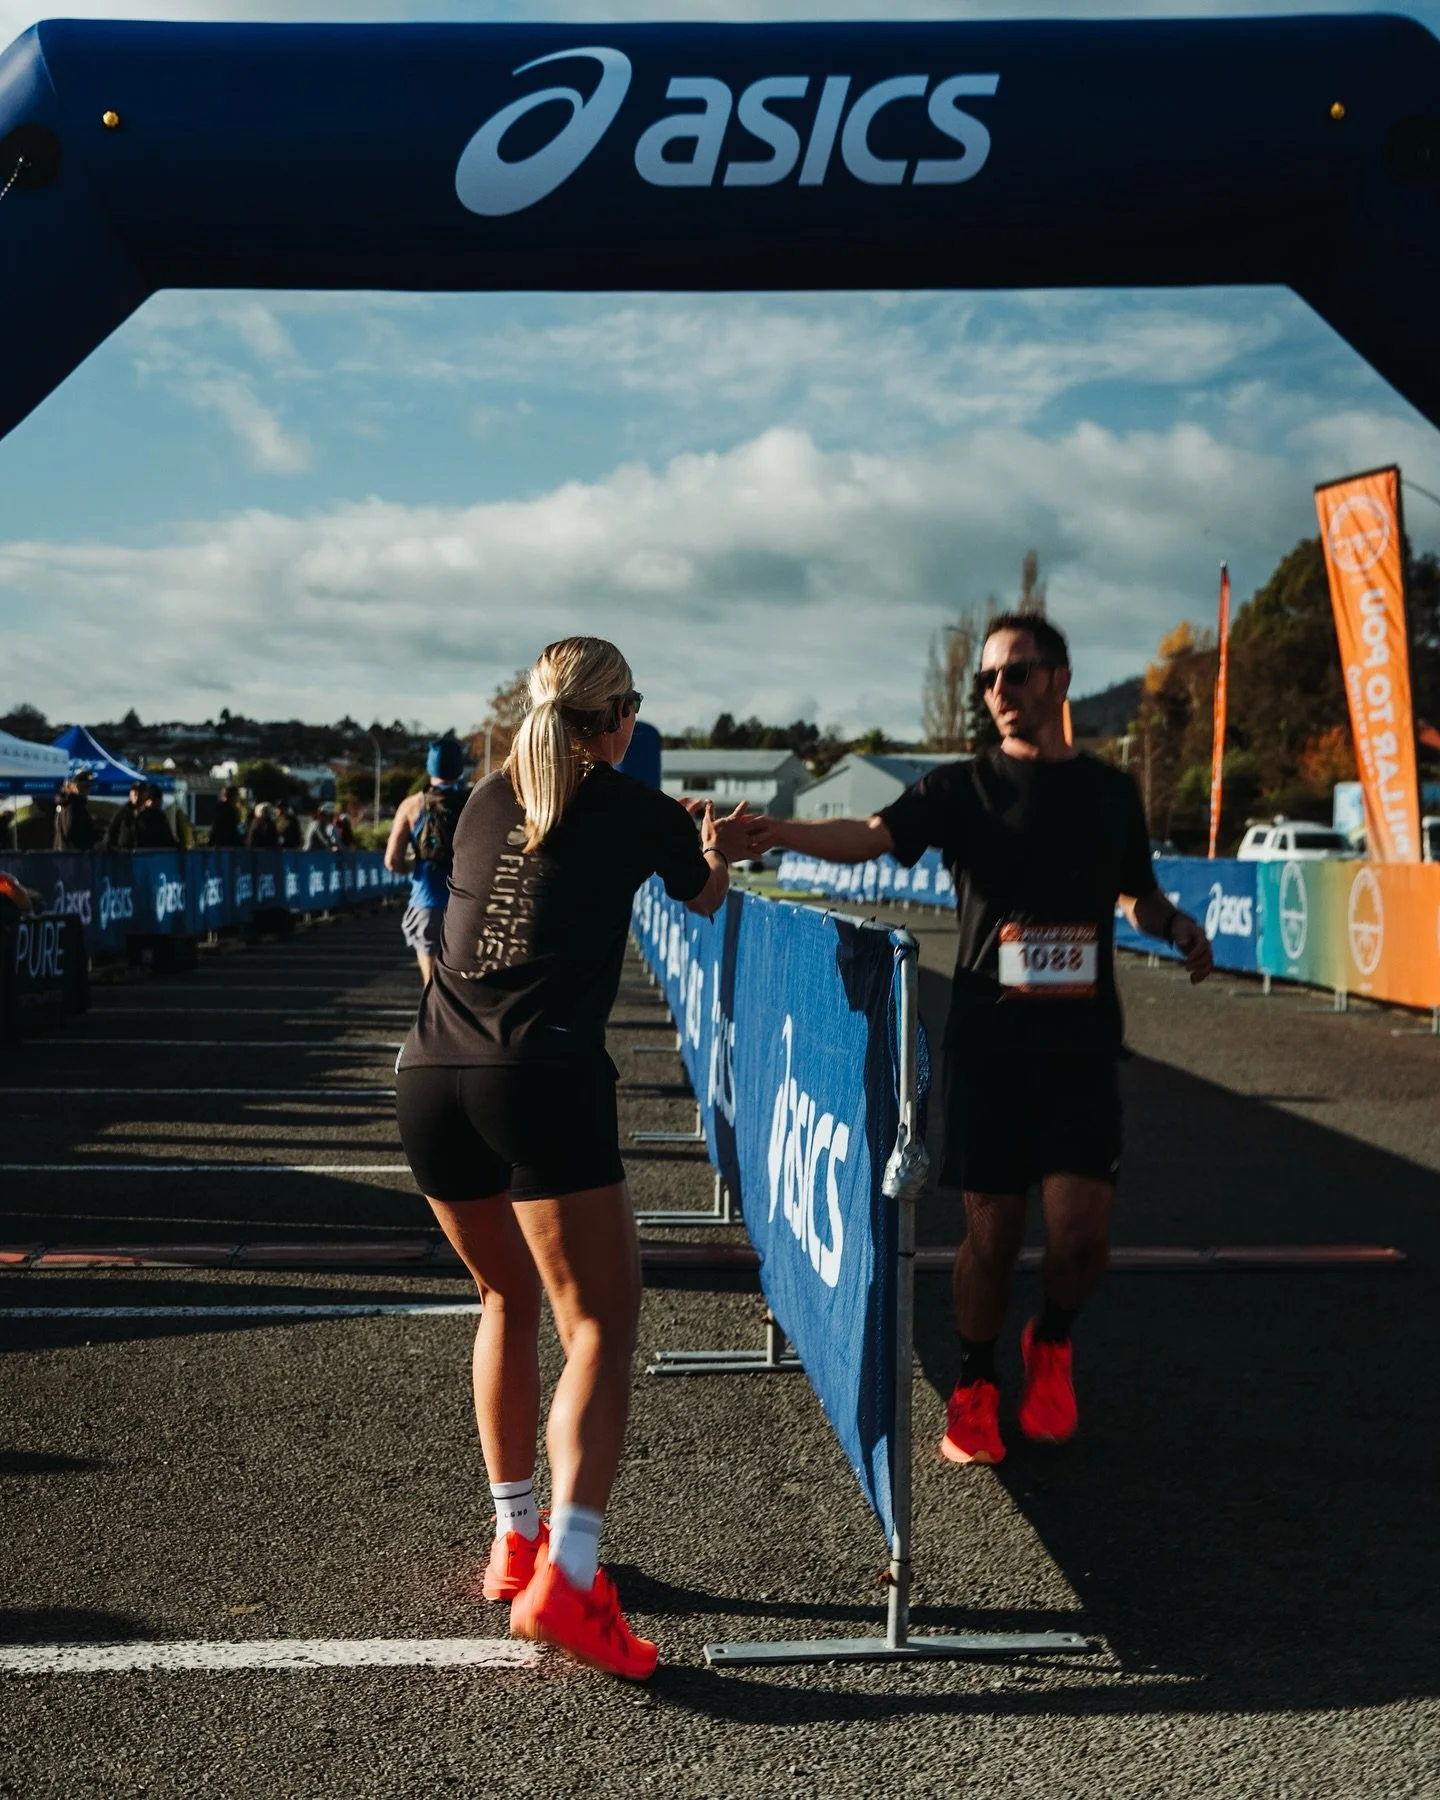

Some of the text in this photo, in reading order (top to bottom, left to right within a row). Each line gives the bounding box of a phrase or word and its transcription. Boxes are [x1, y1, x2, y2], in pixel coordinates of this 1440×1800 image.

[634, 74, 999, 186] asics
[14, 920, 67, 979] PURE
[1018, 945, 1083, 971] 1088
[784, 1078, 850, 1288] asics
